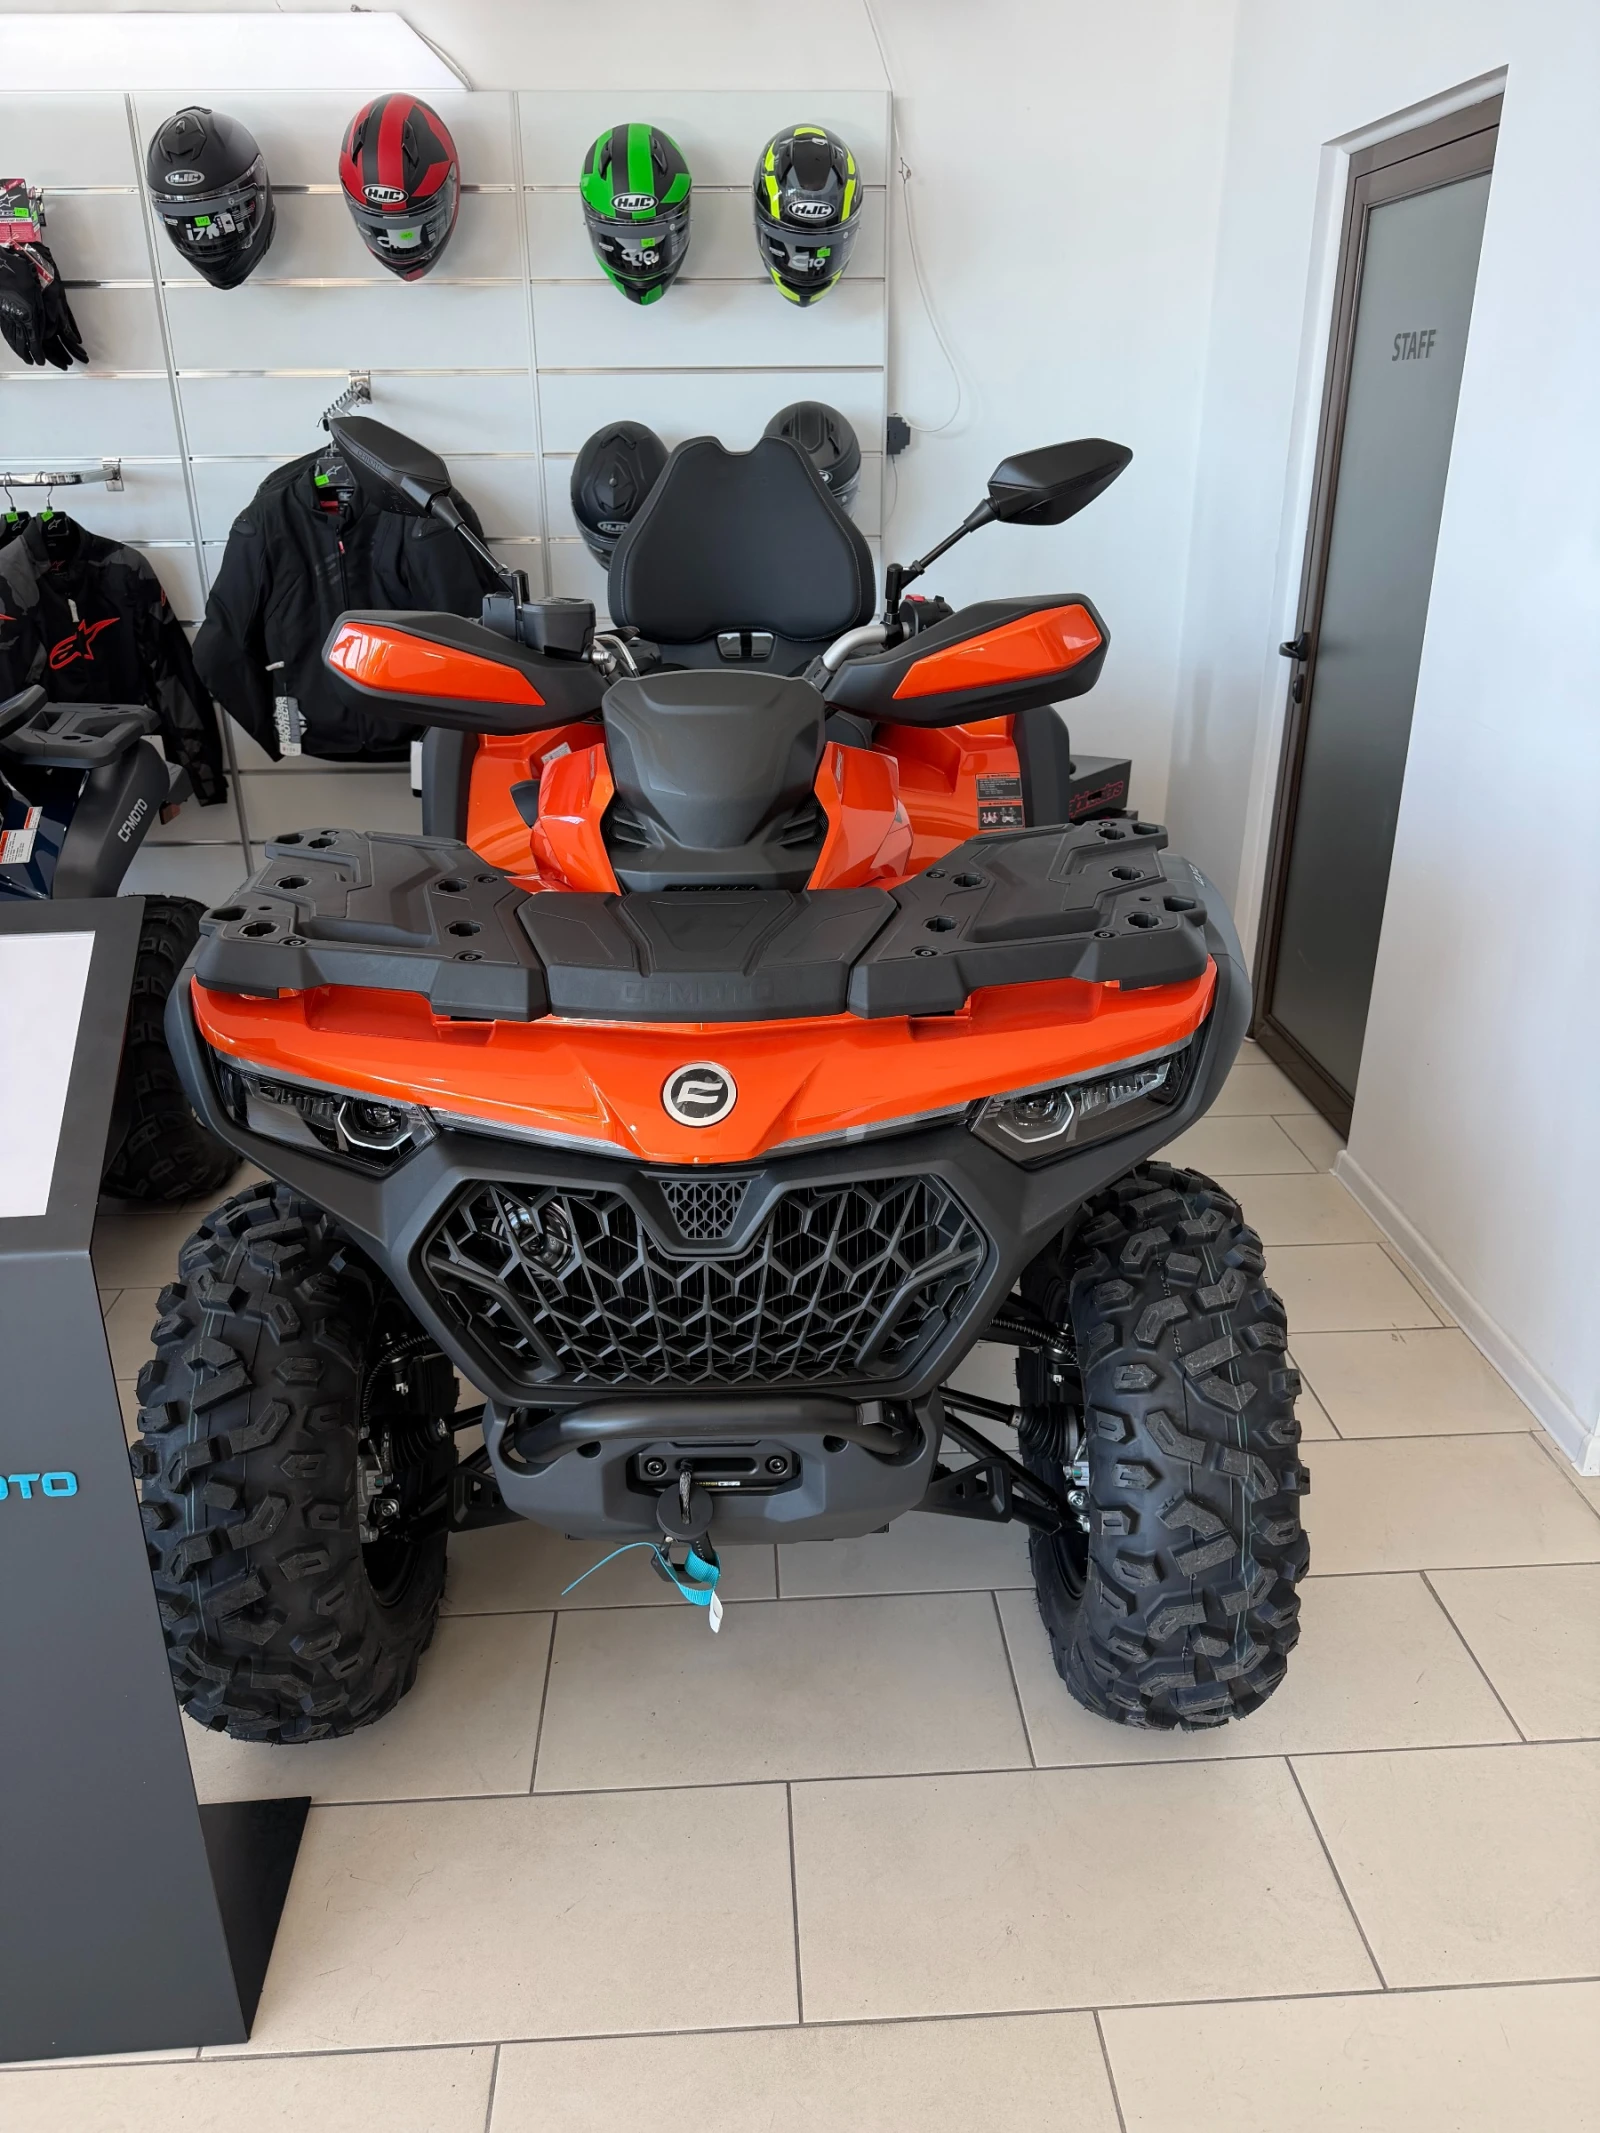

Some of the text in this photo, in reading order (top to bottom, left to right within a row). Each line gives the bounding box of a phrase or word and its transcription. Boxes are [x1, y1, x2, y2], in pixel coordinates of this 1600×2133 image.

[170, 173, 199, 183] HJC
[367, 188, 401, 200] HJC
[617, 197, 651, 208] HJC
[795, 205, 829, 215] HJC
[1392, 329, 1436, 361] STAFF
[117, 798, 148, 842] CFMOTO
[0, 1472, 78, 1500] TO
